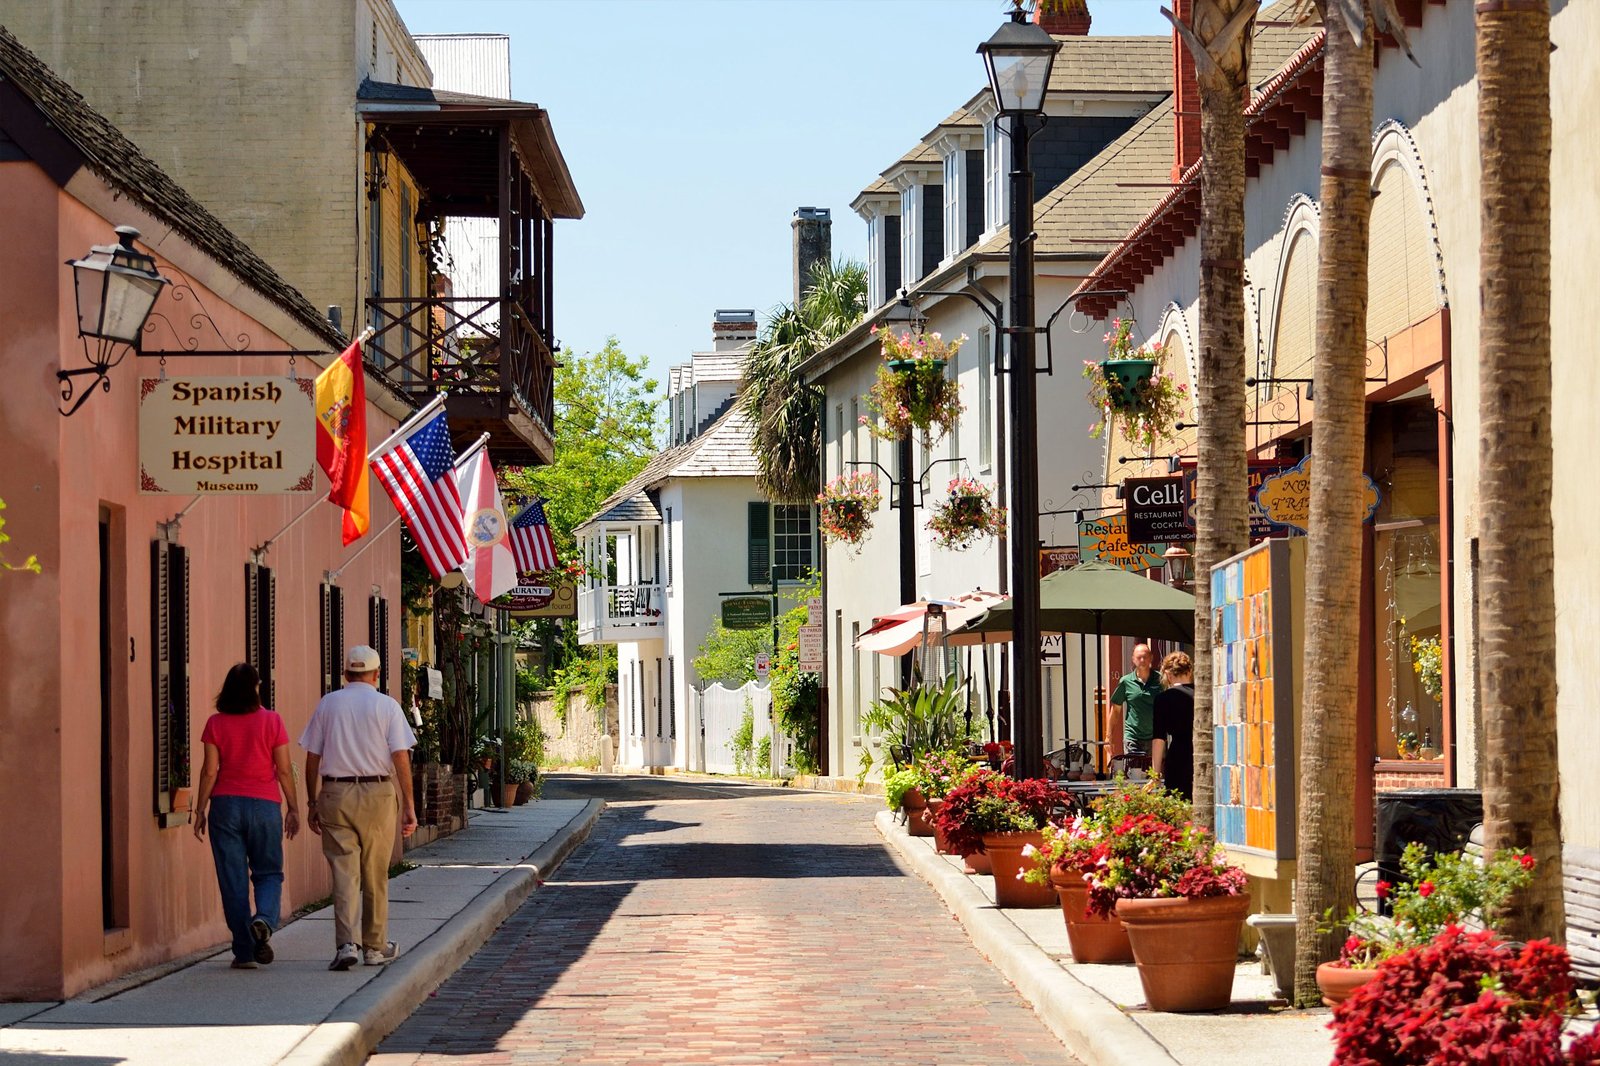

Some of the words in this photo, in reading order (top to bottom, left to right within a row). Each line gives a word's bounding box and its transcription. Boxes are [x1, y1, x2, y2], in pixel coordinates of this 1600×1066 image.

[172, 381, 283, 406] Spanish
[174, 415, 282, 440] Military
[172, 450, 283, 474] Hospital
[197, 481, 259, 491] Museum
[1134, 511, 1183, 520] RESTAURANT
[1164, 533, 1180, 541] MUSIC
